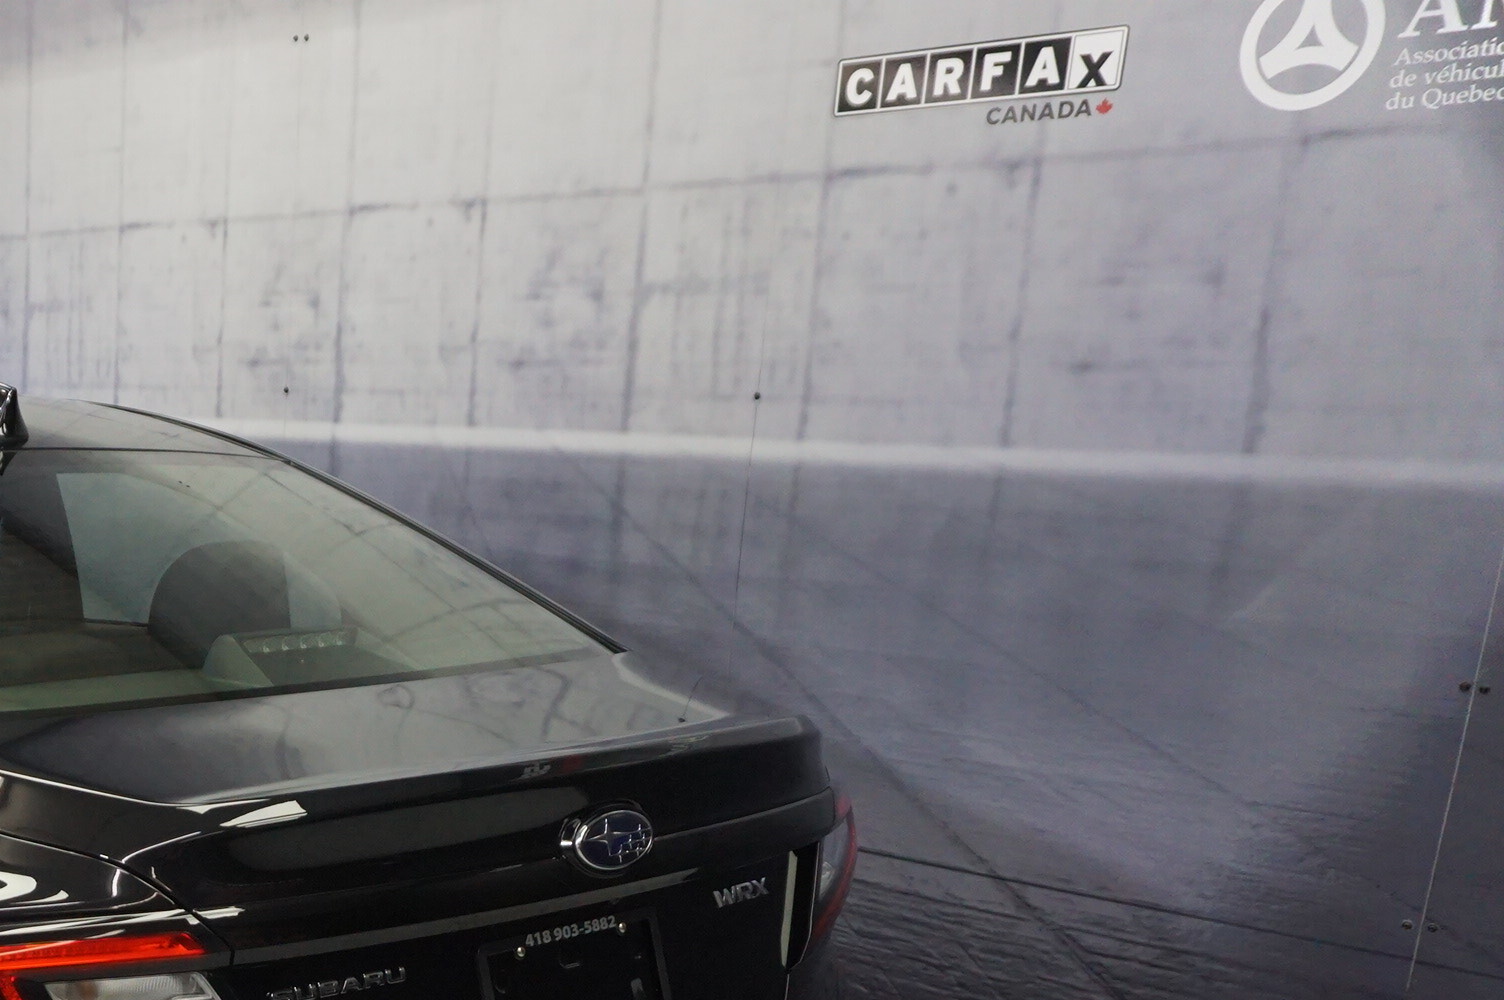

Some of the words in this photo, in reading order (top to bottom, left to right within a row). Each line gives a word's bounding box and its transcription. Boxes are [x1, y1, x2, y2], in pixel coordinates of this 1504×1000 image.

[844, 45, 1116, 106] CARFAX
[1389, 68, 1417, 88] de
[986, 99, 1092, 126] CANADA
[1385, 91, 1415, 110] du
[712, 876, 769, 908] WRX
[524, 929, 553, 948] 418
[553, 914, 617, 942] 903-5882
